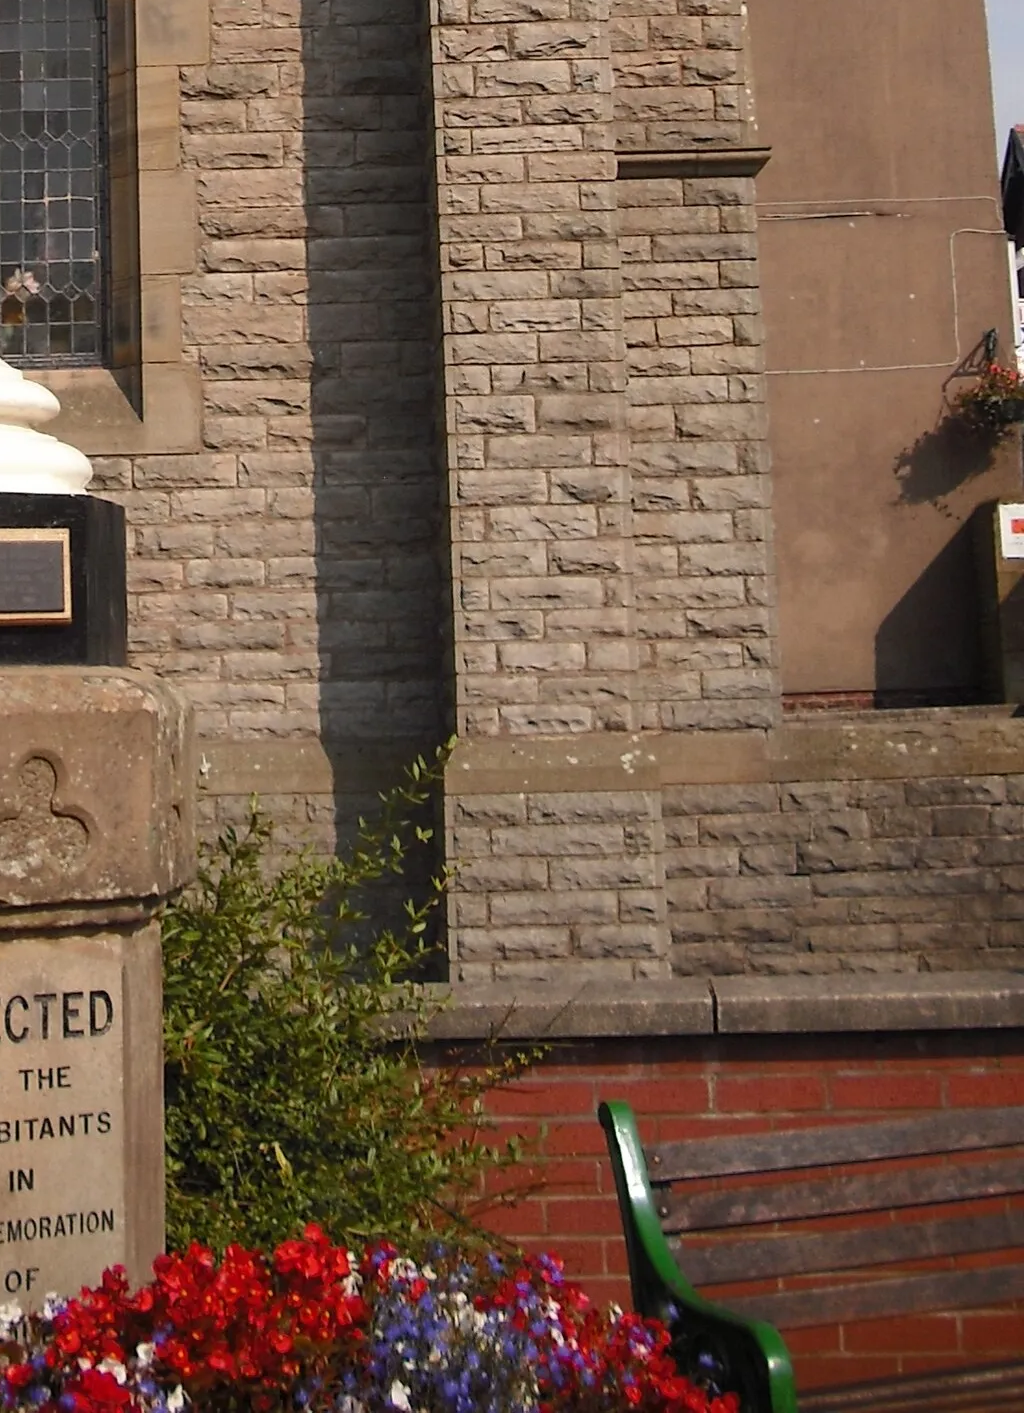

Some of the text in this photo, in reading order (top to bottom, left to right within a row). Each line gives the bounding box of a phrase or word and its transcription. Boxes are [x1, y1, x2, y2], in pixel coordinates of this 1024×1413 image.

[18, 1066, 72, 1091] THE
[8, 1168, 34, 1193] IN
[4, 1267, 40, 1294] OF
